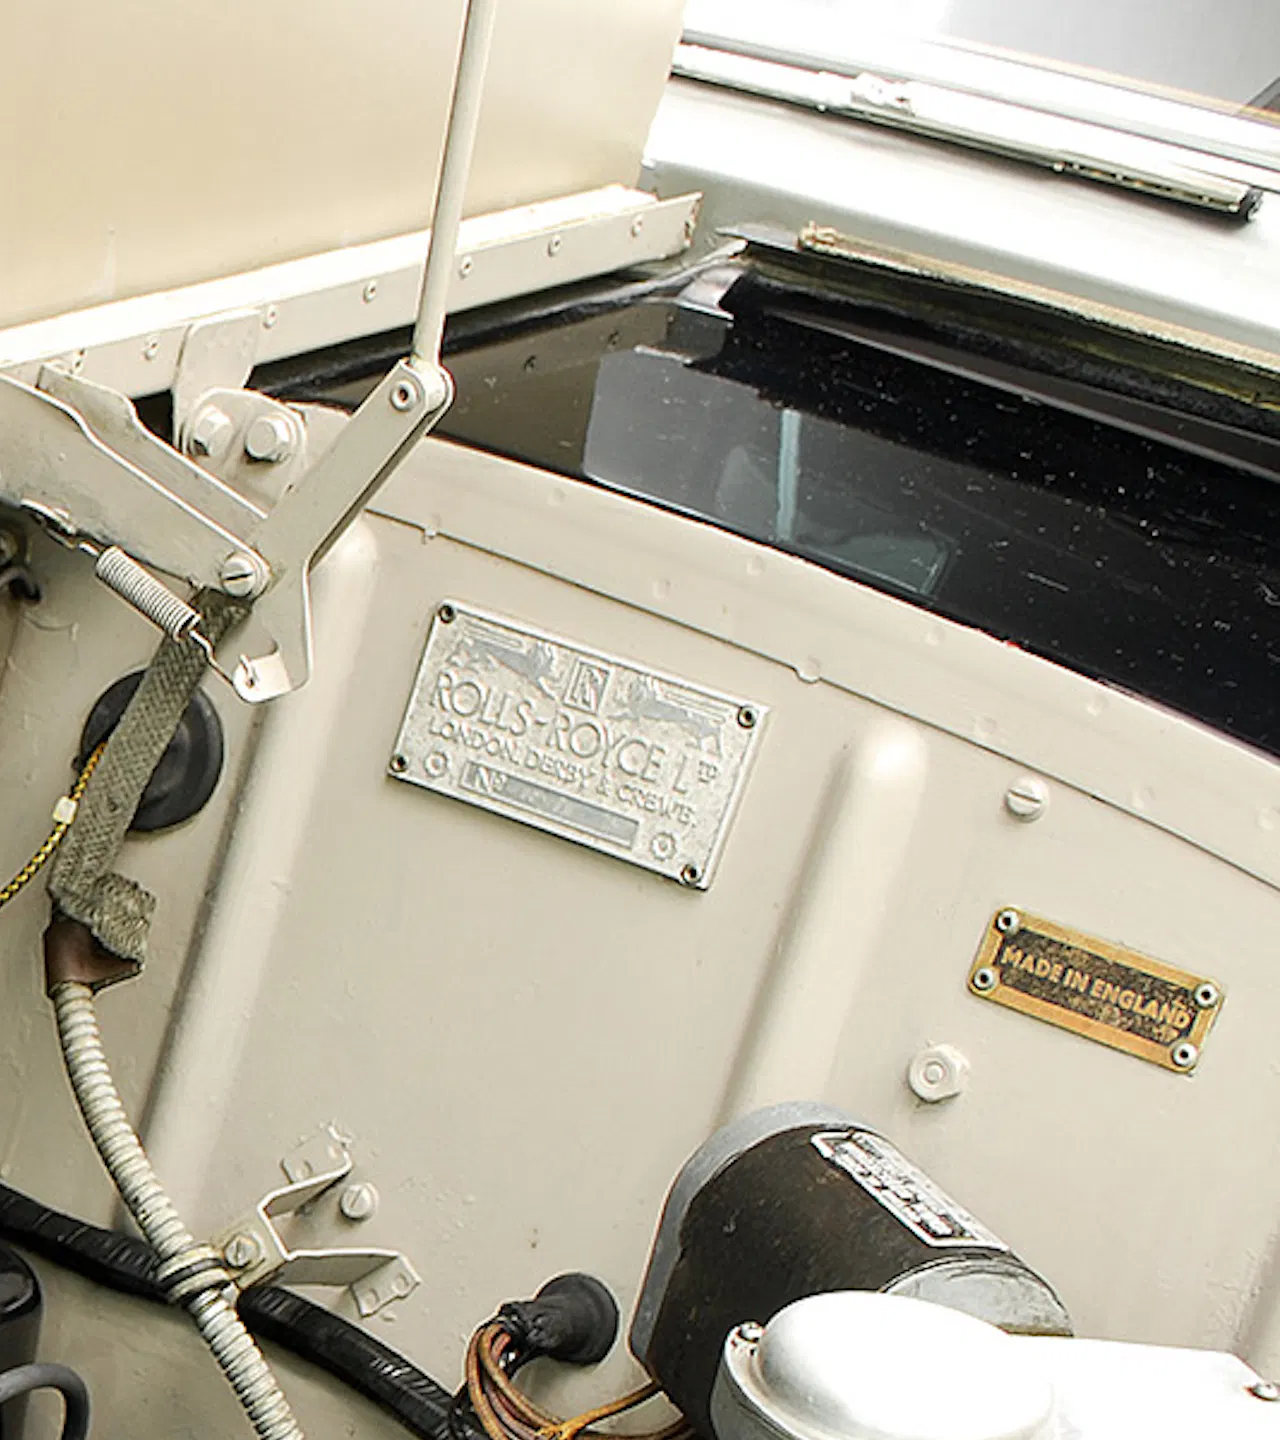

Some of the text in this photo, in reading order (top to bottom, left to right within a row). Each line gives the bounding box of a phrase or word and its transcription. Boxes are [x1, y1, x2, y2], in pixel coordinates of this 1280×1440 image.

[1001, 944, 1191, 1030] MADE IN ENGLAND
